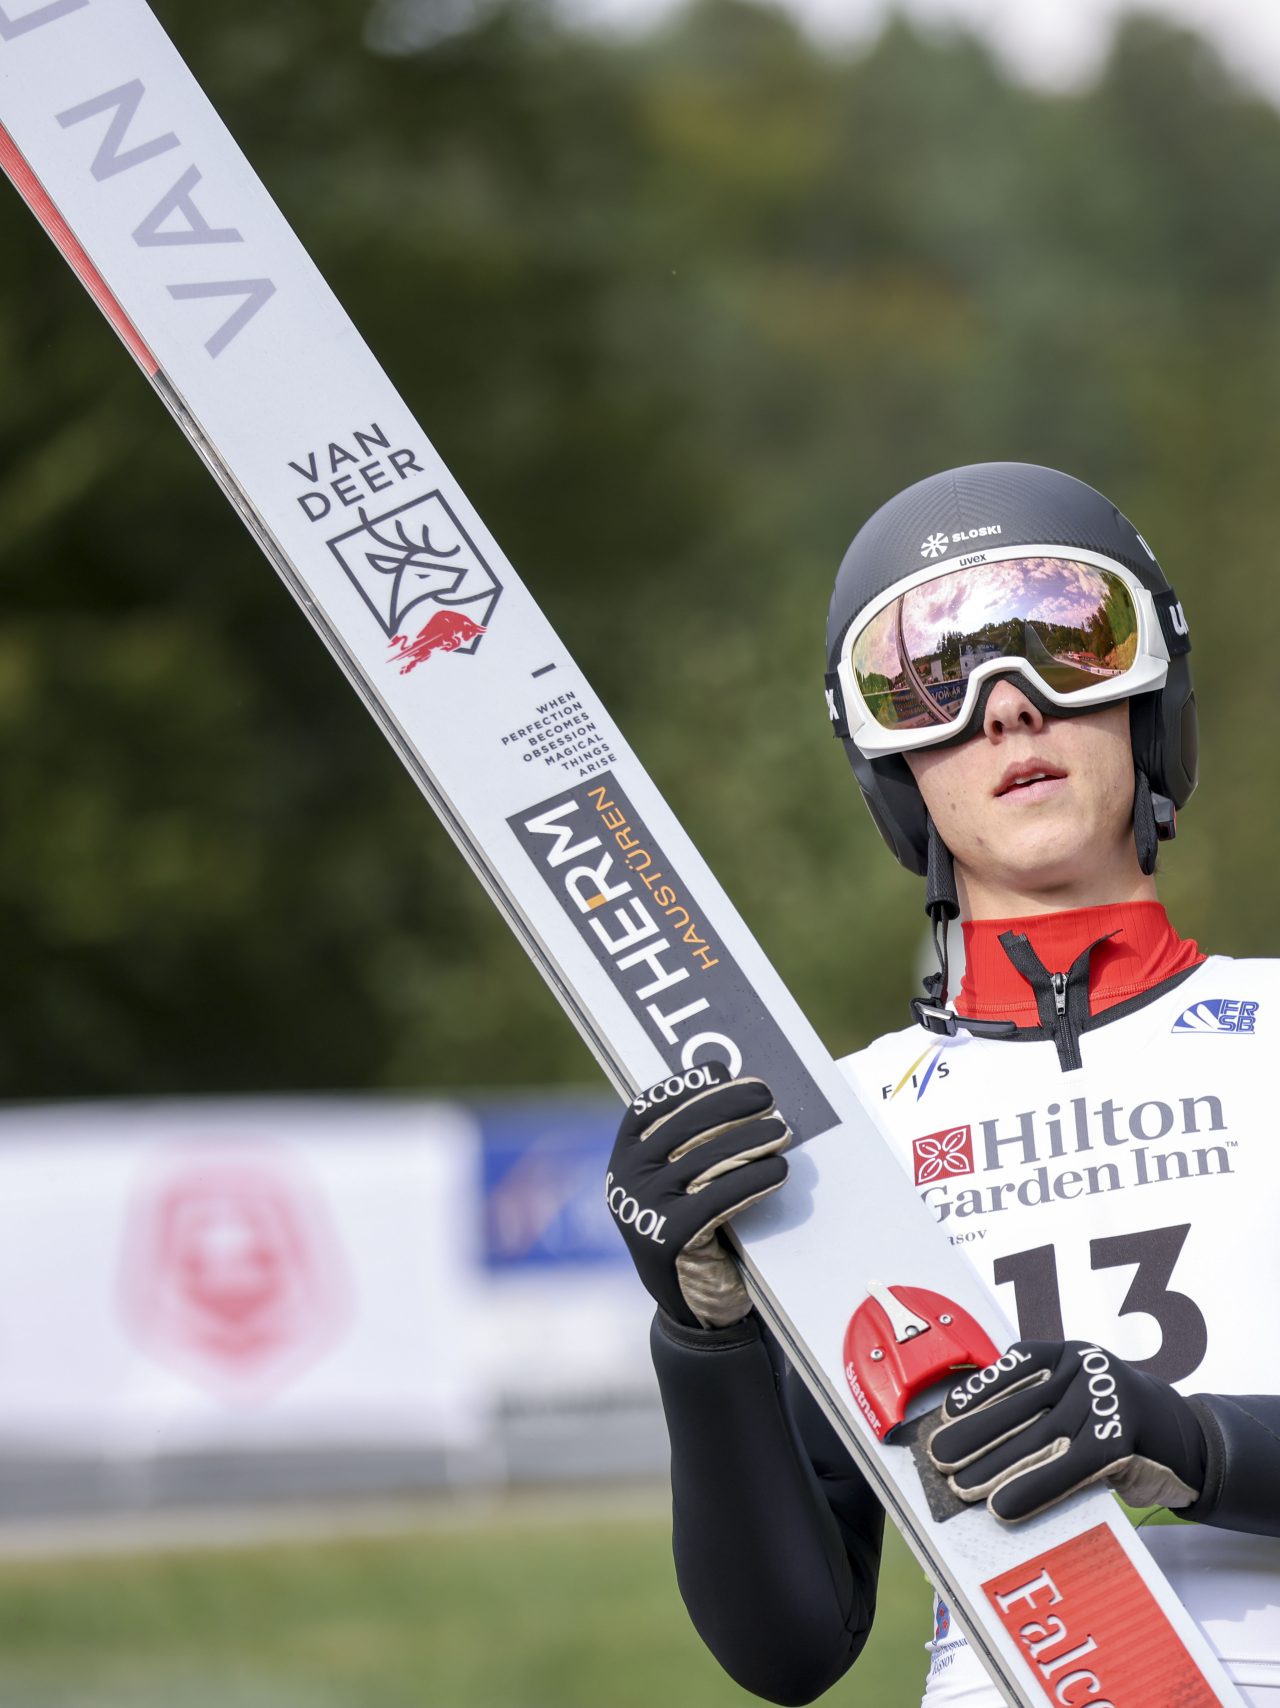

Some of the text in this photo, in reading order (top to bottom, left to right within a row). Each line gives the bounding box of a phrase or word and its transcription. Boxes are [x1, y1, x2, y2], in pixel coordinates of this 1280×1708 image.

[55, 78, 277, 360] VAN
[287, 422, 391, 483] VAN
[297, 448, 424, 522] DEER
[952, 525, 1002, 542] SLOSKI
[959, 554, 987, 567] uvex
[501, 702, 583, 746] PERFECTION
[536, 691, 576, 714] WHEN
[523, 722, 597, 762] OBSESSION
[528, 712, 590, 746] BECOMES
[544, 734, 604, 766] MAGICAL
[561, 743, 610, 771] THINGS
[579, 753, 617, 777] ARISE
[587, 786, 720, 970] HAUSTÜREN
[633, 1066, 720, 1115] S.COOL
[979, 1094, 1228, 1171] Hilton
[920, 1166, 1125, 1223] Garden
[993, 1222, 1208, 1385] 13
[951, 1349, 1032, 1410] S.COOL
[995, 1568, 1116, 1708] Falc
